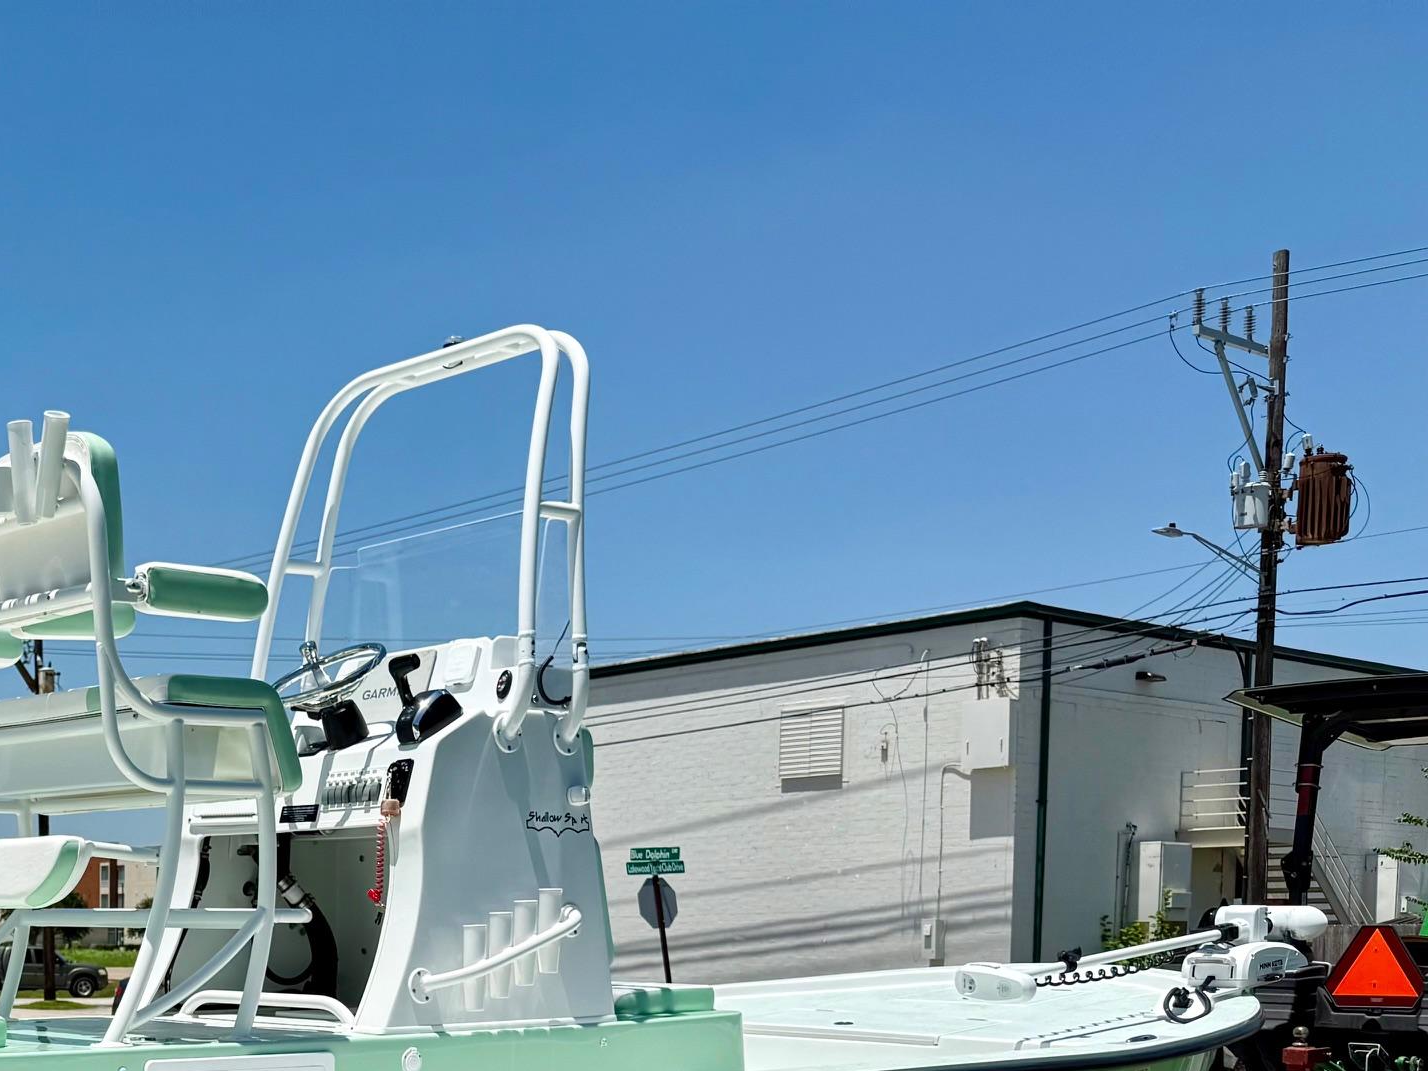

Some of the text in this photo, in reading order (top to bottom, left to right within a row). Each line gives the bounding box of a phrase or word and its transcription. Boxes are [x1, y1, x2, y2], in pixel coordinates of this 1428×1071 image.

[362, 687, 399, 700] GARM
[630, 849, 643, 859] Blue
[645, 849, 670, 860] Dolphin
